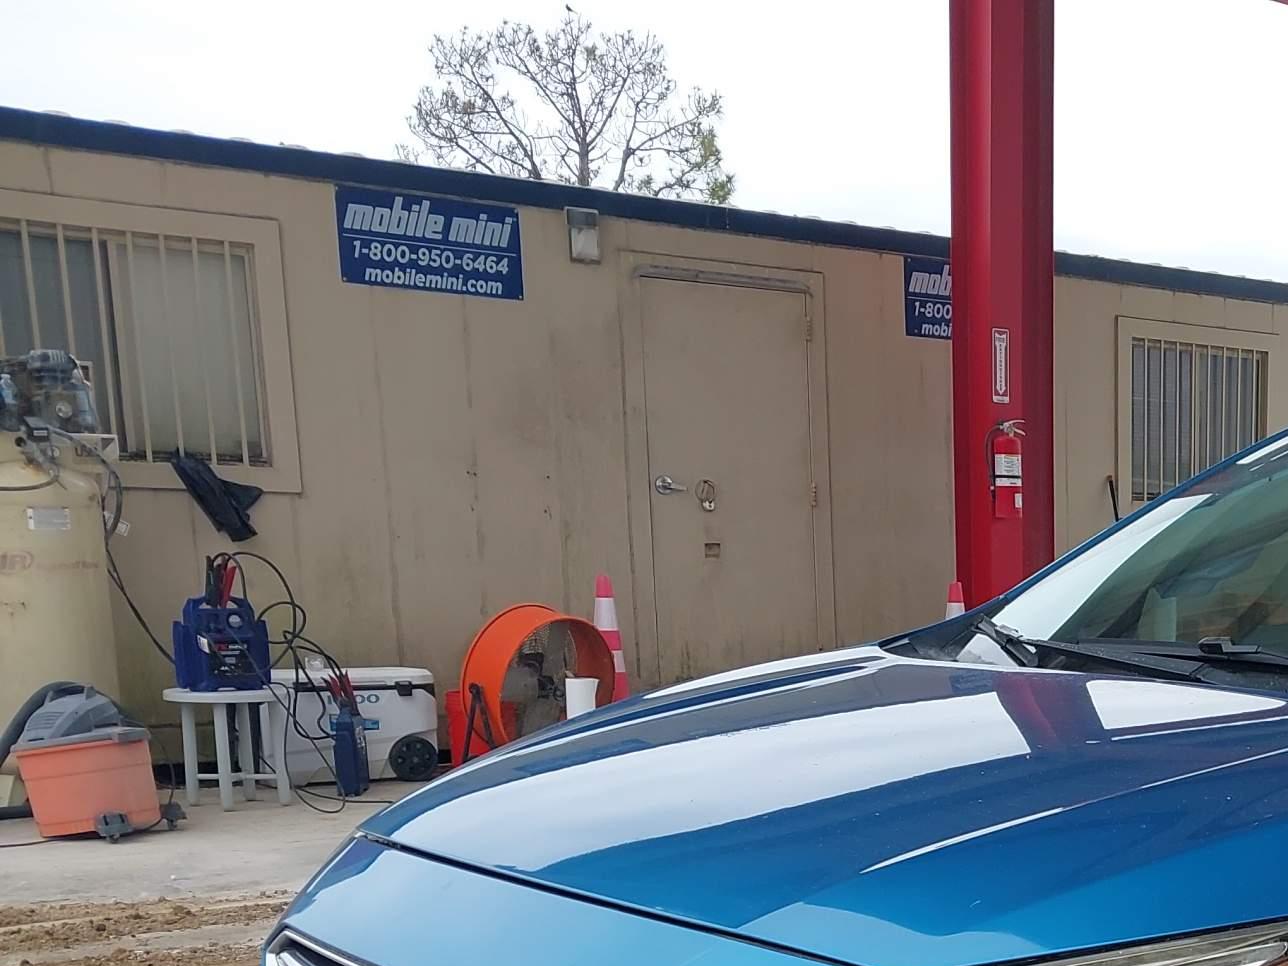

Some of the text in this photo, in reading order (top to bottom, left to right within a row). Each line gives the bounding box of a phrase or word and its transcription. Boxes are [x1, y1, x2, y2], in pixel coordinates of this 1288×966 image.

[343, 196, 513, 248] mobile mini
[352, 240, 509, 275] 1-800-950-6464
[364, 267, 503, 295] mobilemini.com
[914, 301, 953, 319] 1-800
